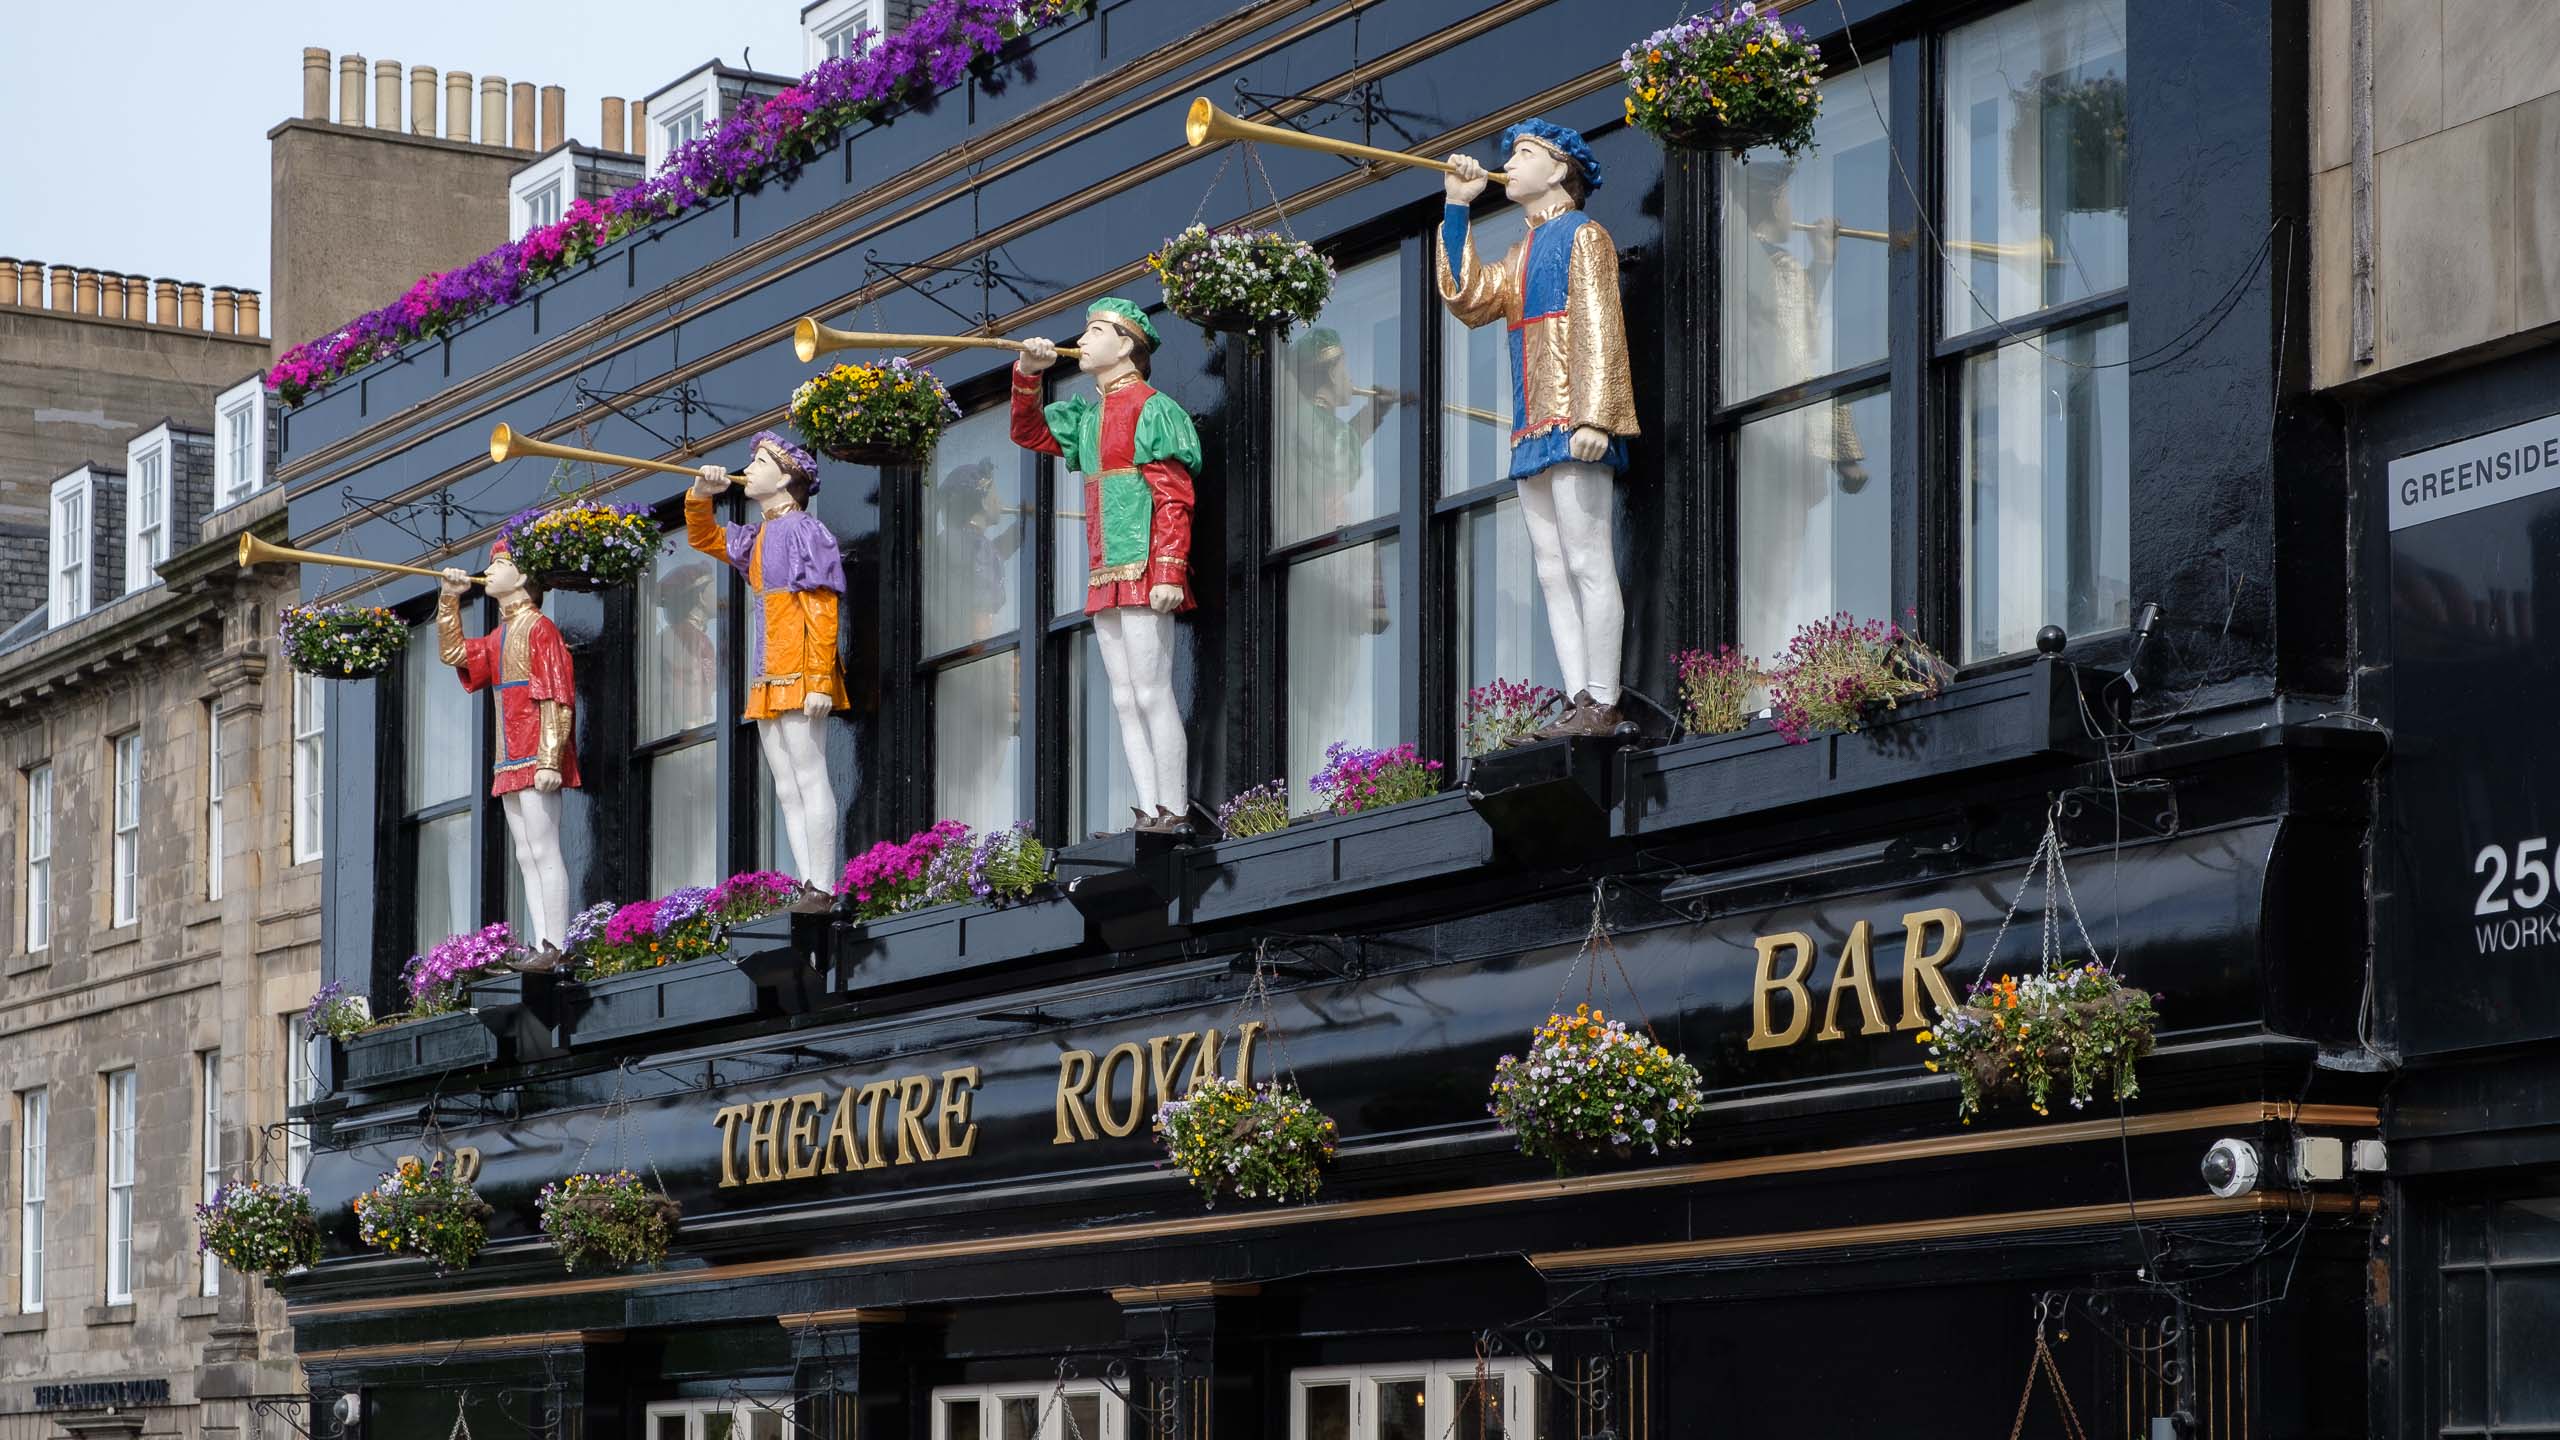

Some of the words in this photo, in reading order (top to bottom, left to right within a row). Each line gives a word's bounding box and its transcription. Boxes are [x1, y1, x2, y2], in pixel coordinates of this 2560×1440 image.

[2401, 438, 2559, 506] GREENSIDE
[2474, 836, 2560, 916] 25
[1747, 907, 1962, 1050] BAR
[713, 1066, 981, 1188] THEATRE
